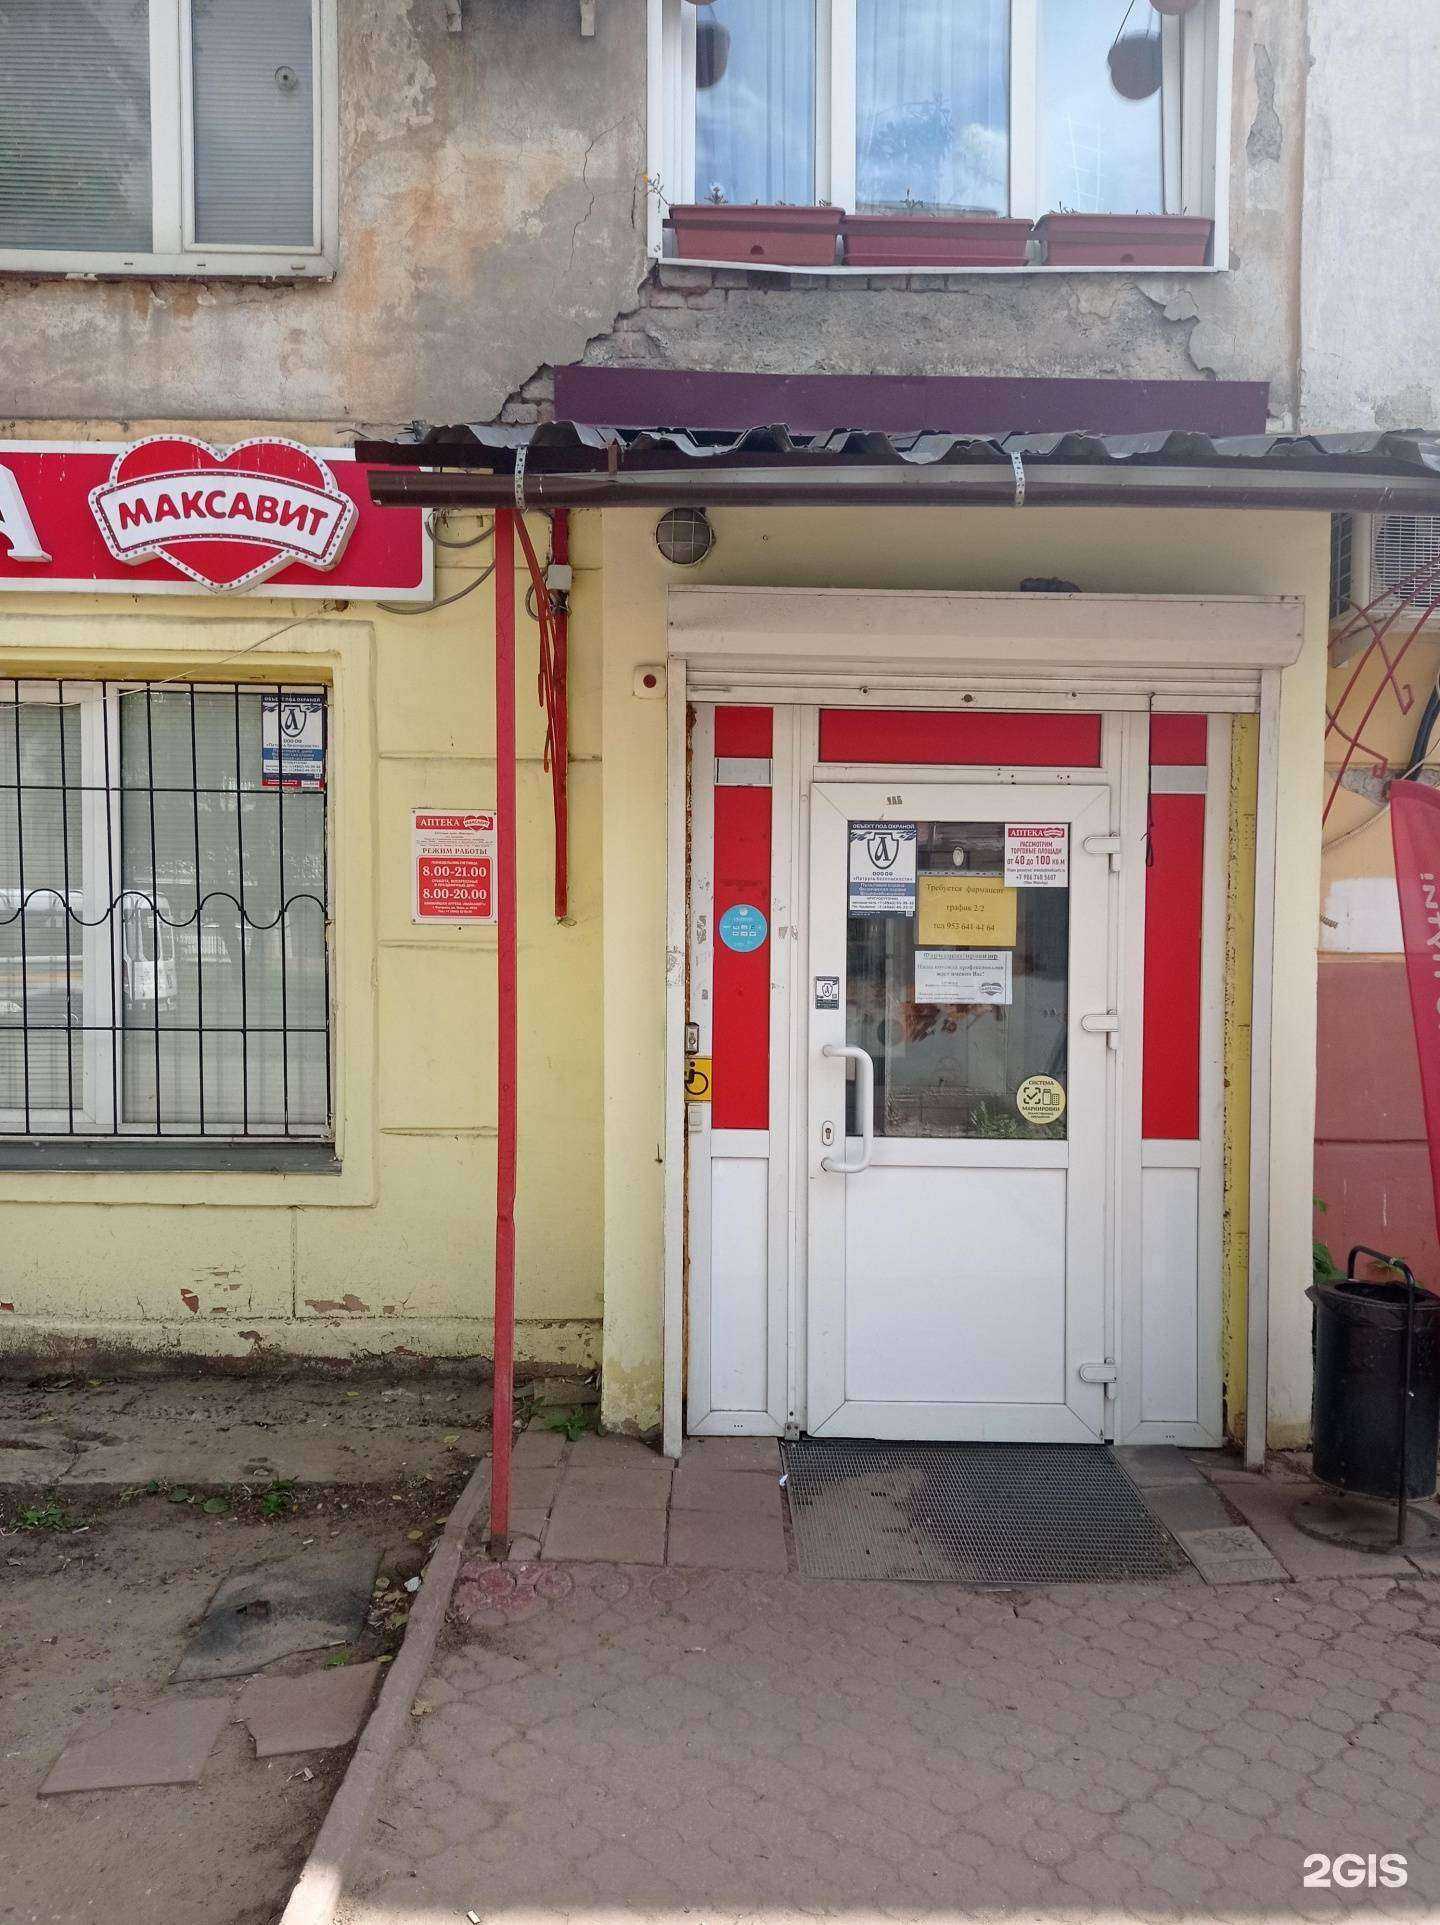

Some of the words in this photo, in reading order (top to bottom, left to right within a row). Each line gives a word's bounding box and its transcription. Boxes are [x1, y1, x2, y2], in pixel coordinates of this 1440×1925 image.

[118, 490, 328, 536] МАКСАВИТ
[420, 818, 461, 827] АПТЕКА
[1010, 829, 1044, 837] АПТЕКА
[422, 847, 453, 855] РЕЖИМ
[1036, 855, 1051, 865] 100
[422, 865, 487, 877] 8.00-21.00
[422, 888, 487, 900] 8.00-20.00
